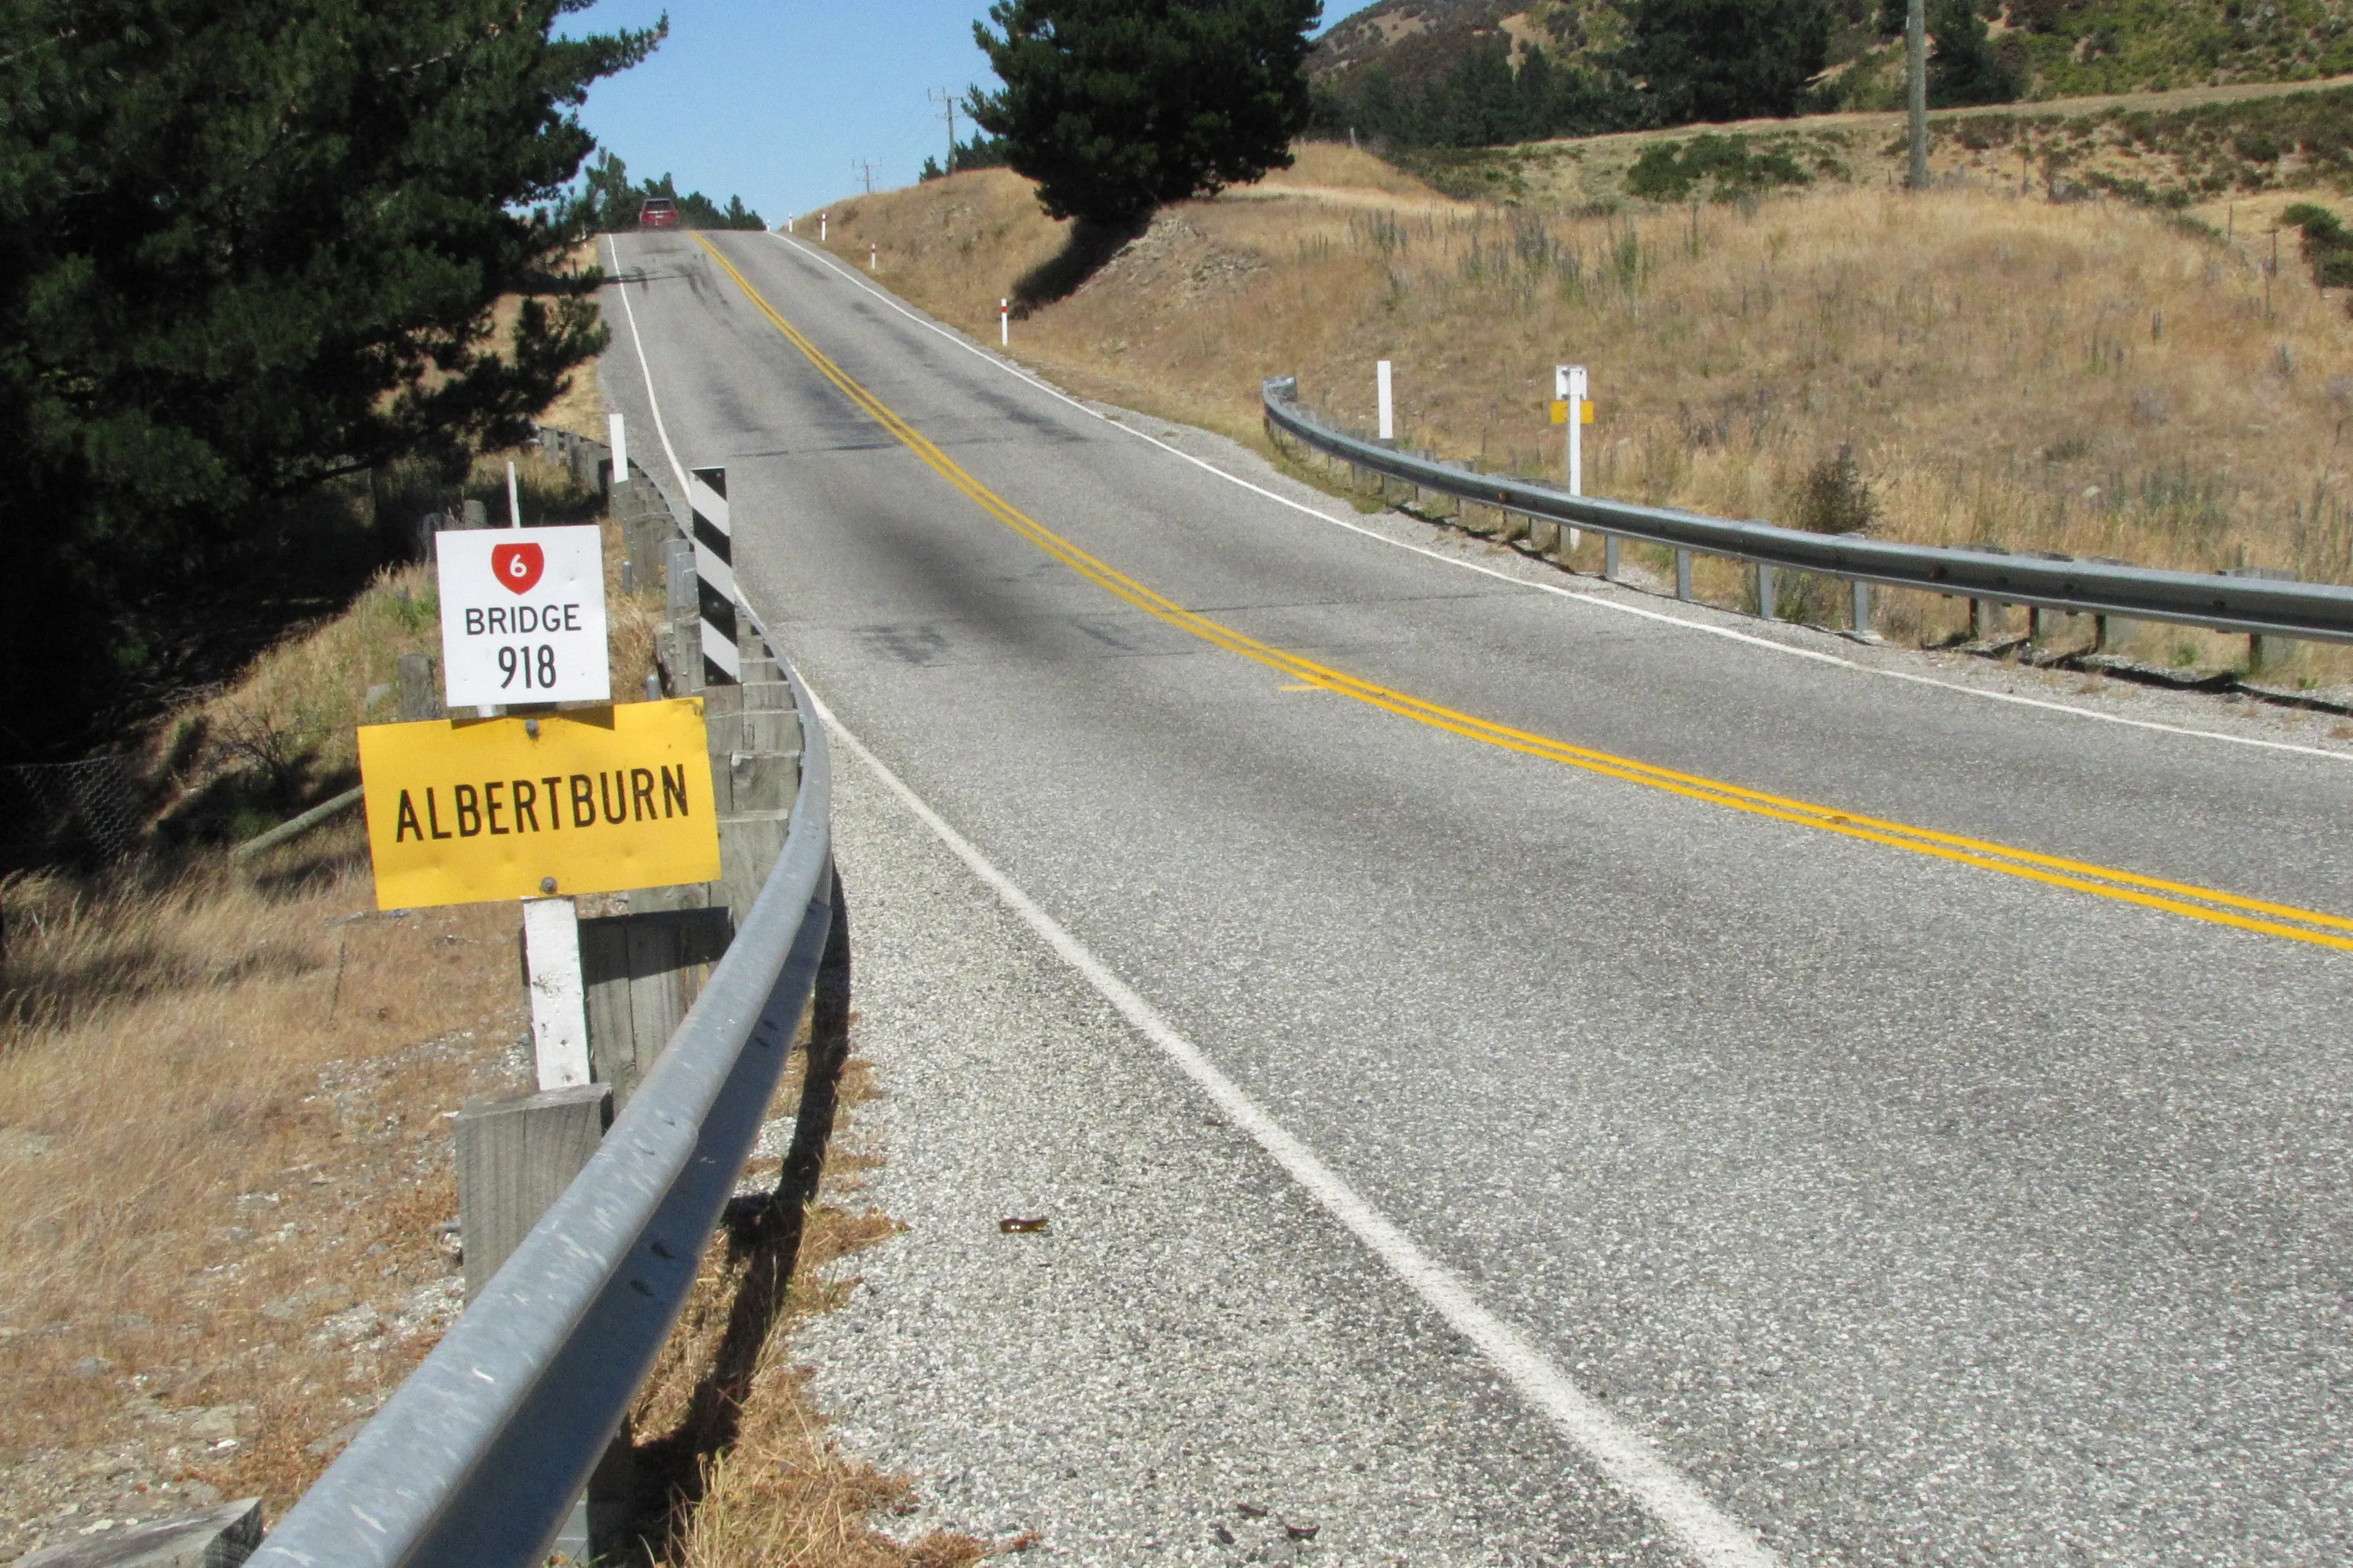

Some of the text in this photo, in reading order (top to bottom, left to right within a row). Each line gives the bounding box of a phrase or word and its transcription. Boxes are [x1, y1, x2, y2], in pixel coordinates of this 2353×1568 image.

[509, 553, 527, 578] 6
[466, 604, 582, 635] BRIDGE
[498, 644, 556, 689] 918
[396, 763, 689, 843] ALBERTBURN
